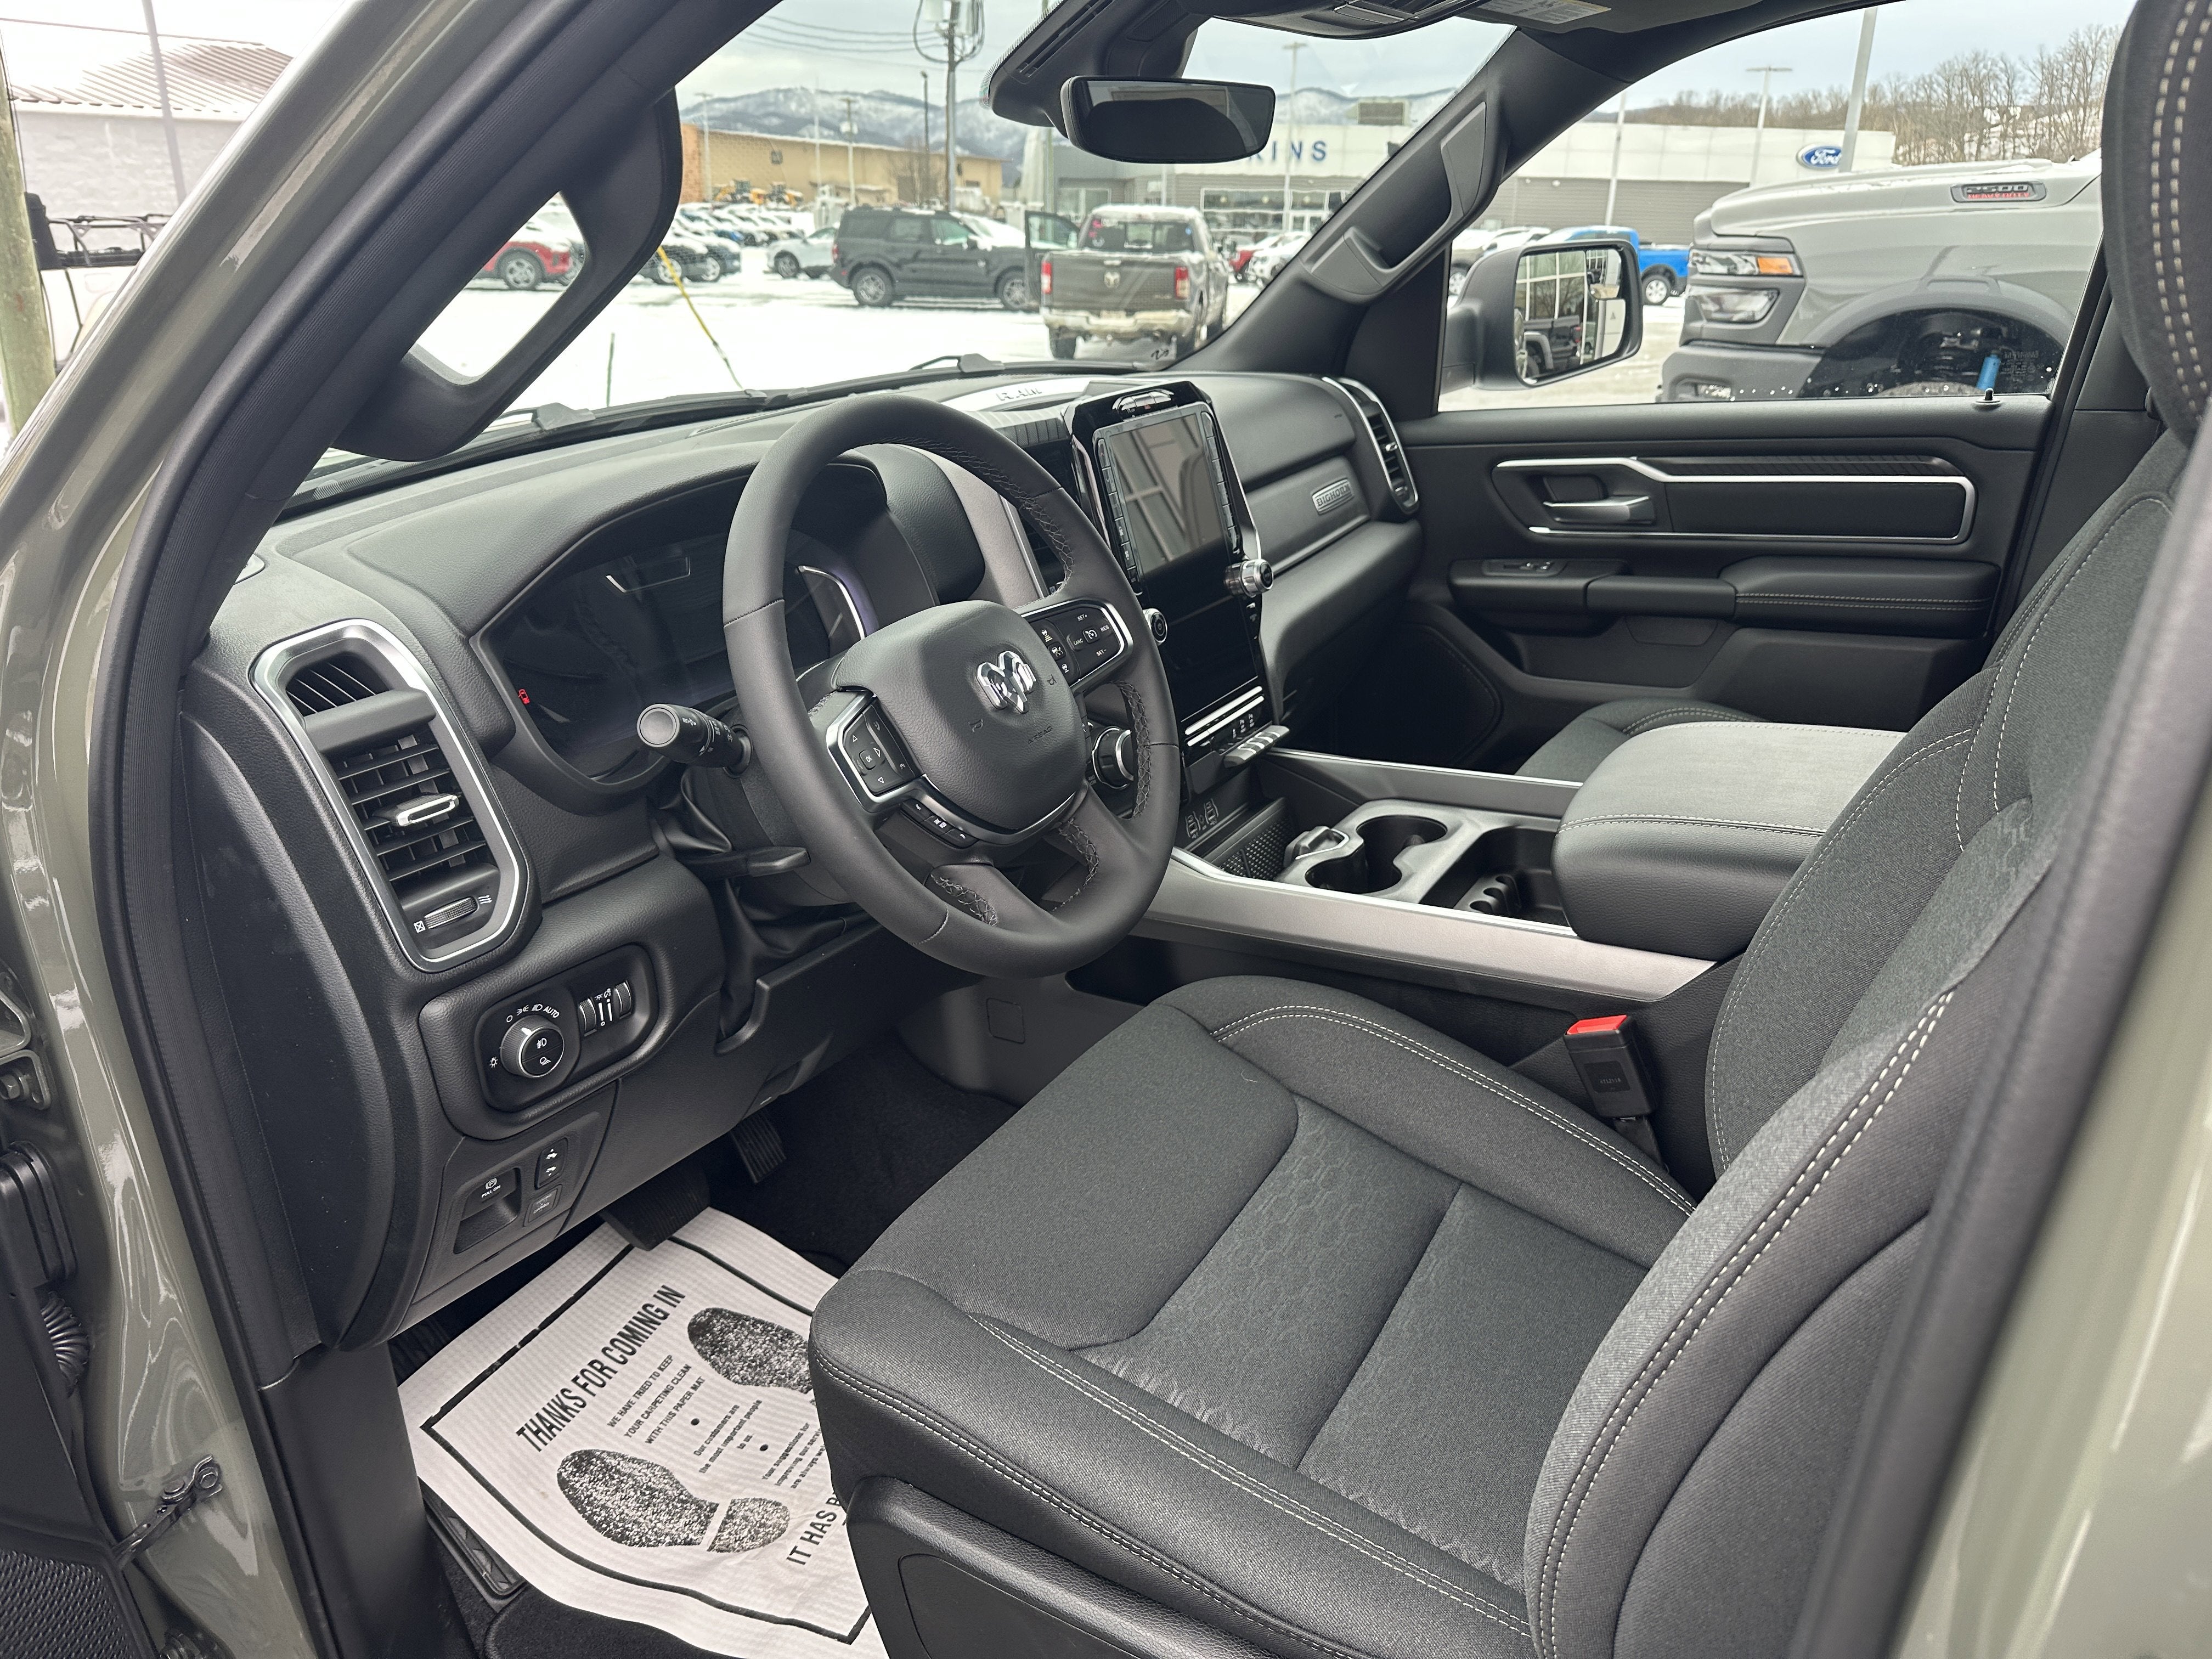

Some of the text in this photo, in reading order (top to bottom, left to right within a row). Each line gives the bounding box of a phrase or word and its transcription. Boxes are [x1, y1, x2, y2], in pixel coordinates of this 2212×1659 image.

[1810, 149, 1842, 165] Ford
[543, 1006, 560, 1018] AUTO
[516, 1285, 685, 1452] THANKS FOR COMING IN
[607, 1355, 673, 1427] WE HAVE TRIED TO KEEP
[624, 1364, 692, 1438] YOUR CARPETING CLEAN
[645, 1376, 706, 1444] WITH THIS PAPER MAT
[693, 1404, 740, 1456] Our customers are
[699, 1400, 762, 1474] the most important people
[761, 1423, 810, 1480] Your suggestions for
[799, 1446, 810, 1456] our
[791, 1479, 802, 1488] are
[799, 1457, 819, 1478] always
[786, 1545, 811, 1565] IT
[800, 1510, 837, 1545] HAS
